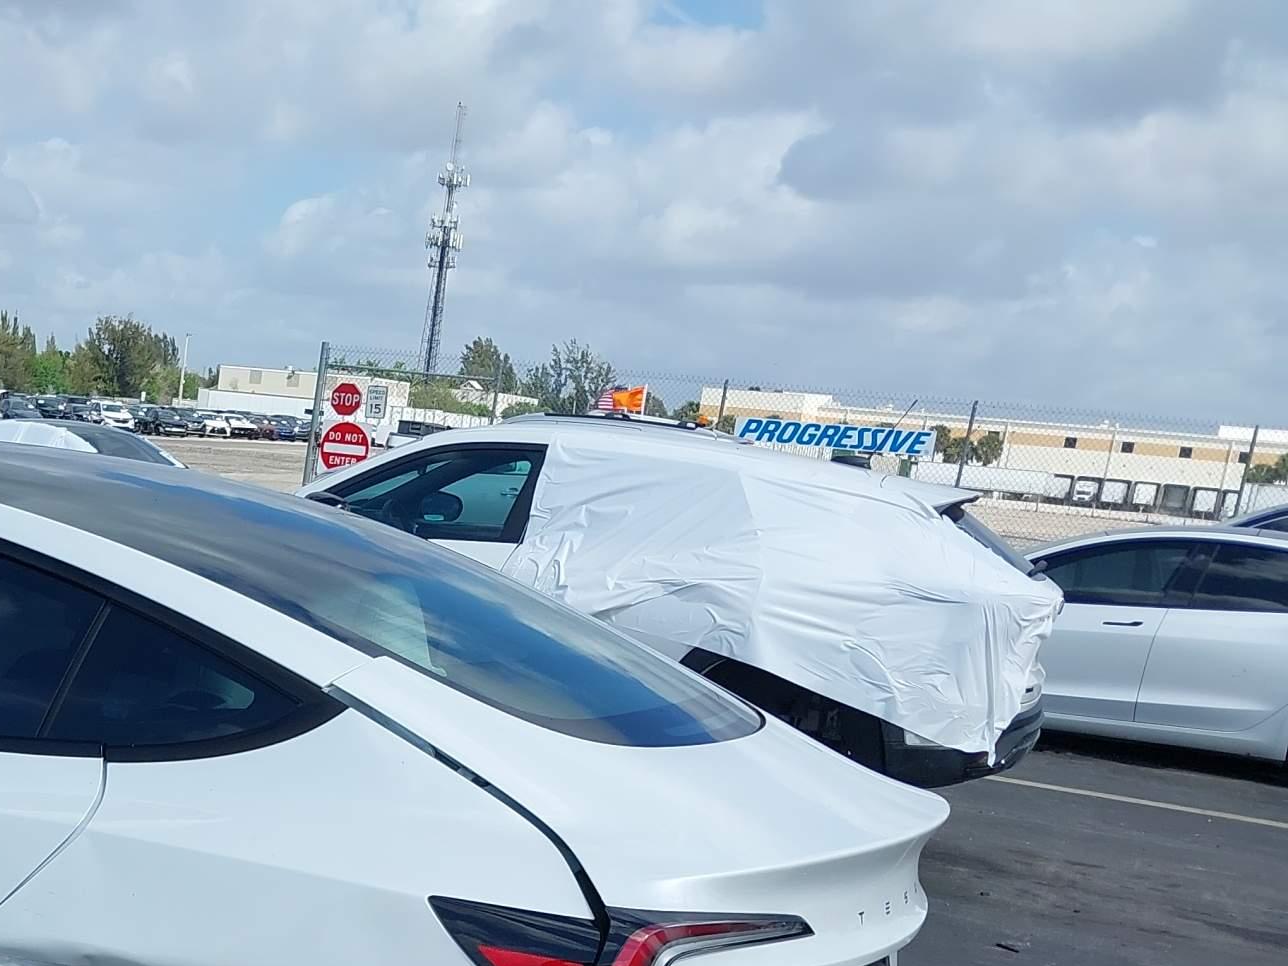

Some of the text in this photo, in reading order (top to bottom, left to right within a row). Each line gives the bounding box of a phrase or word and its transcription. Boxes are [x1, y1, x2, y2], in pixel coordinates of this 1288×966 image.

[332, 392, 360, 407] STOP
[370, 403, 381, 414] 15
[328, 431, 364, 443] DO NOT
[739, 418, 932, 455] PROGRESSIVE
